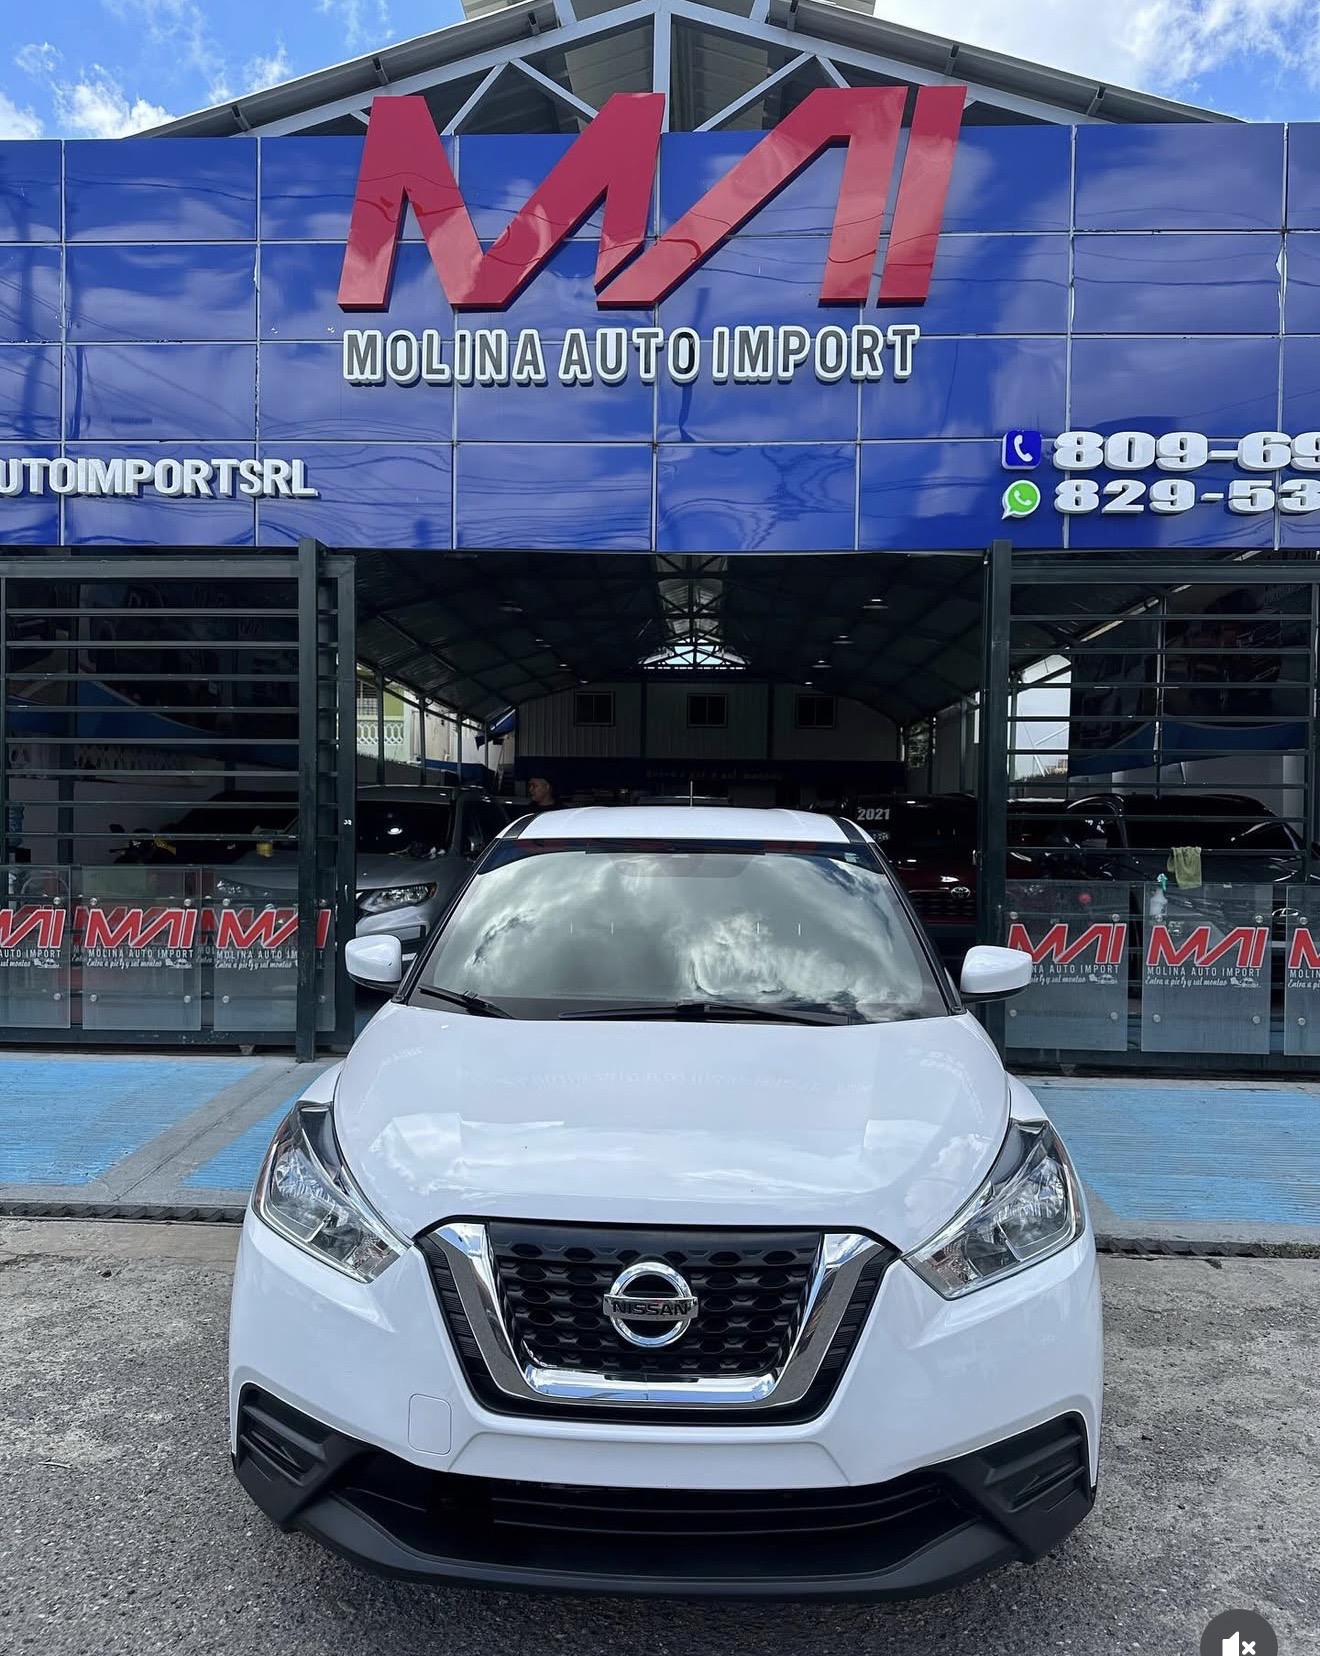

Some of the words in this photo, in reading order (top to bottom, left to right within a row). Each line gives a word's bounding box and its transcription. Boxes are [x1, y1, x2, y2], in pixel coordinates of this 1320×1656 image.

[343, 329, 546, 387] MOLINA
[558, 327, 700, 385] AUTO
[712, 325, 920, 384] IMPORT
[857, 808, 890, 820] 2021
[26, 949, 61, 958] IMPORT
[88, 949, 124, 958] MOLINA
[128, 949, 153, 958] AUTO
[157, 949, 194, 958] IMPORT
[216, 950, 253, 959] MOLINA
[258, 950, 283, 959] AUTO
[87, 958, 103, 967] Entra
[1049, 965, 1076, 974] AUTO
[1080, 965, 1120, 974] IMPORT
[1147, 967, 1186, 976] MOLINA
[1191, 967, 1217, 977] AUTO
[1222, 968, 1261, 977] IMPORT
[1145, 976, 1163, 985] Entra
[1287, 979, 1305, 988] Entra
[612, 1301, 690, 1316] NISSAN
